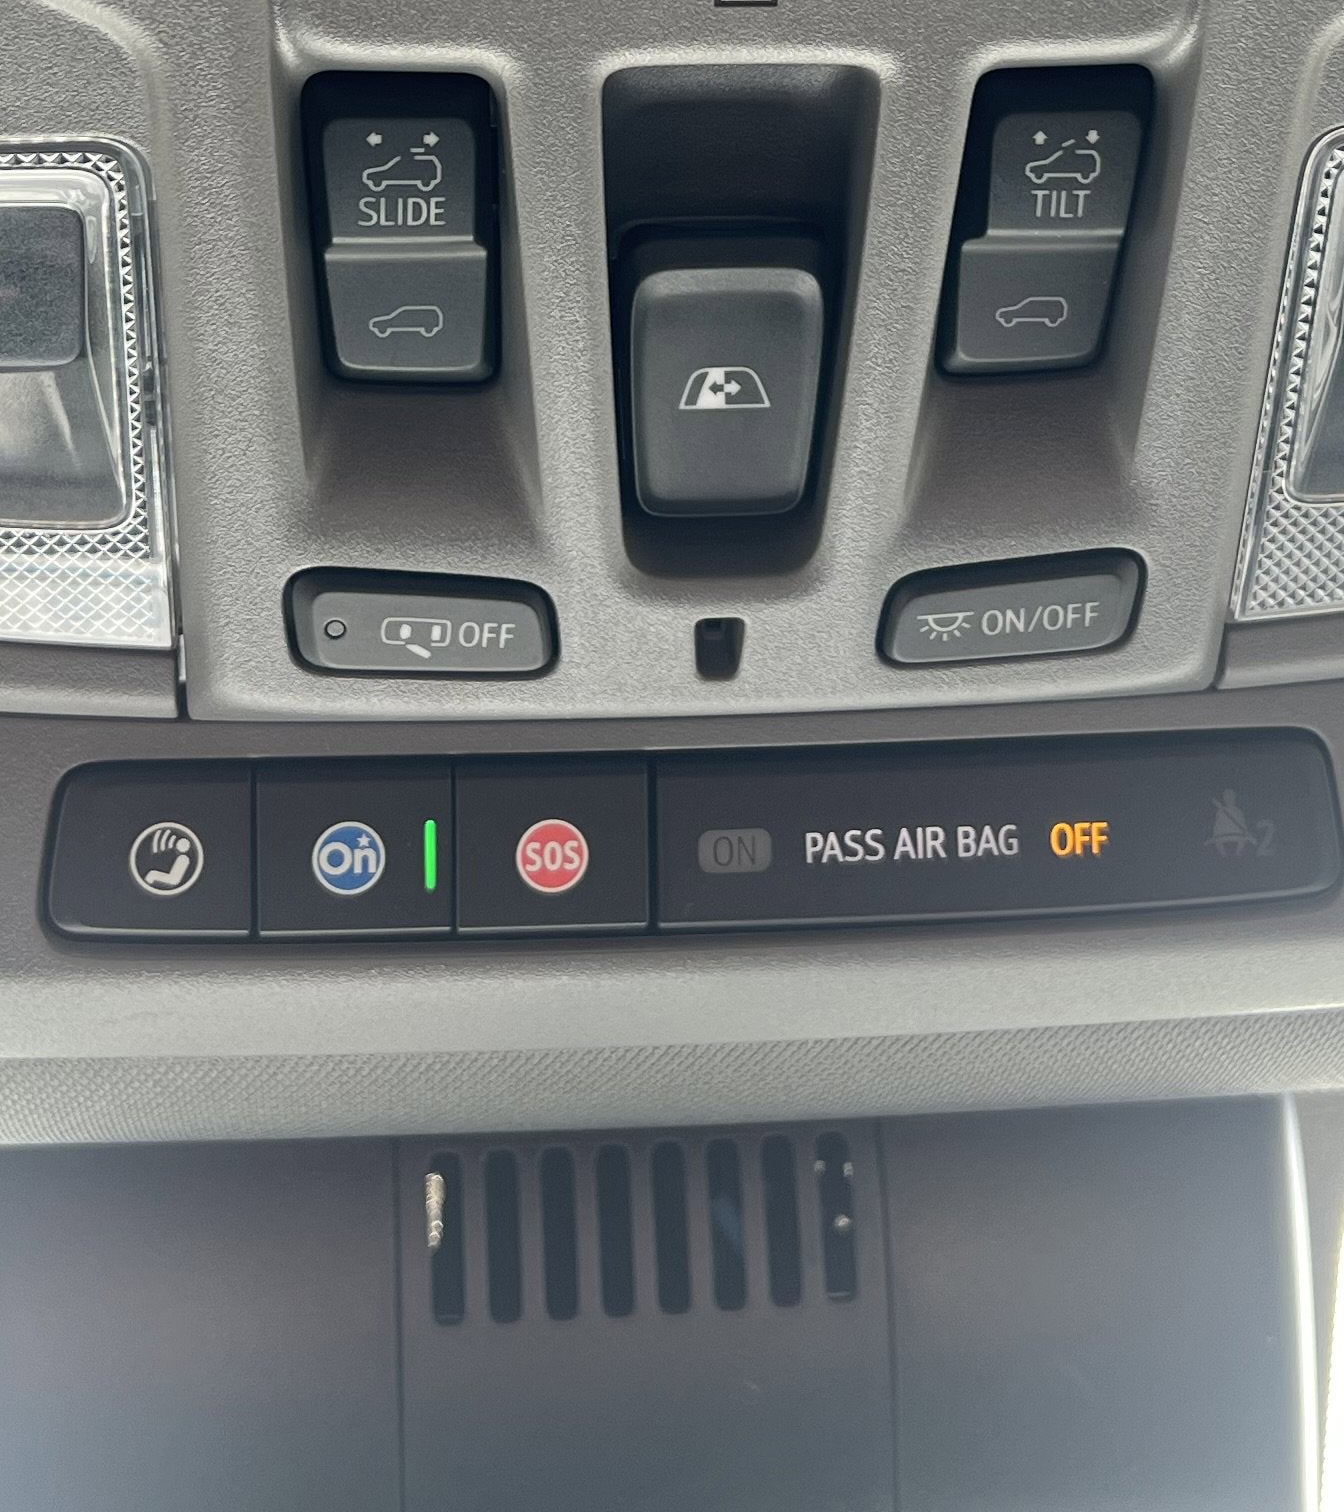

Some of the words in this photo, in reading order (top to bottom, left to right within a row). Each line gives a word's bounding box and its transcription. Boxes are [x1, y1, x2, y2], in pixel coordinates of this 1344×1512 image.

[358, 197, 446, 226] SLIDE
[1031, 190, 1090, 219] TILT
[458, 621, 516, 648] OFF
[981, 601, 1100, 636] ON/OFF
[318, 841, 376, 875] On
[524, 841, 581, 872] SOS
[712, 834, 758, 867] ON
[805, 829, 885, 864] PASS
[893, 826, 946, 860] AIR
[957, 824, 1019, 857] BAG
[1050, 821, 1109, 856] OFF
